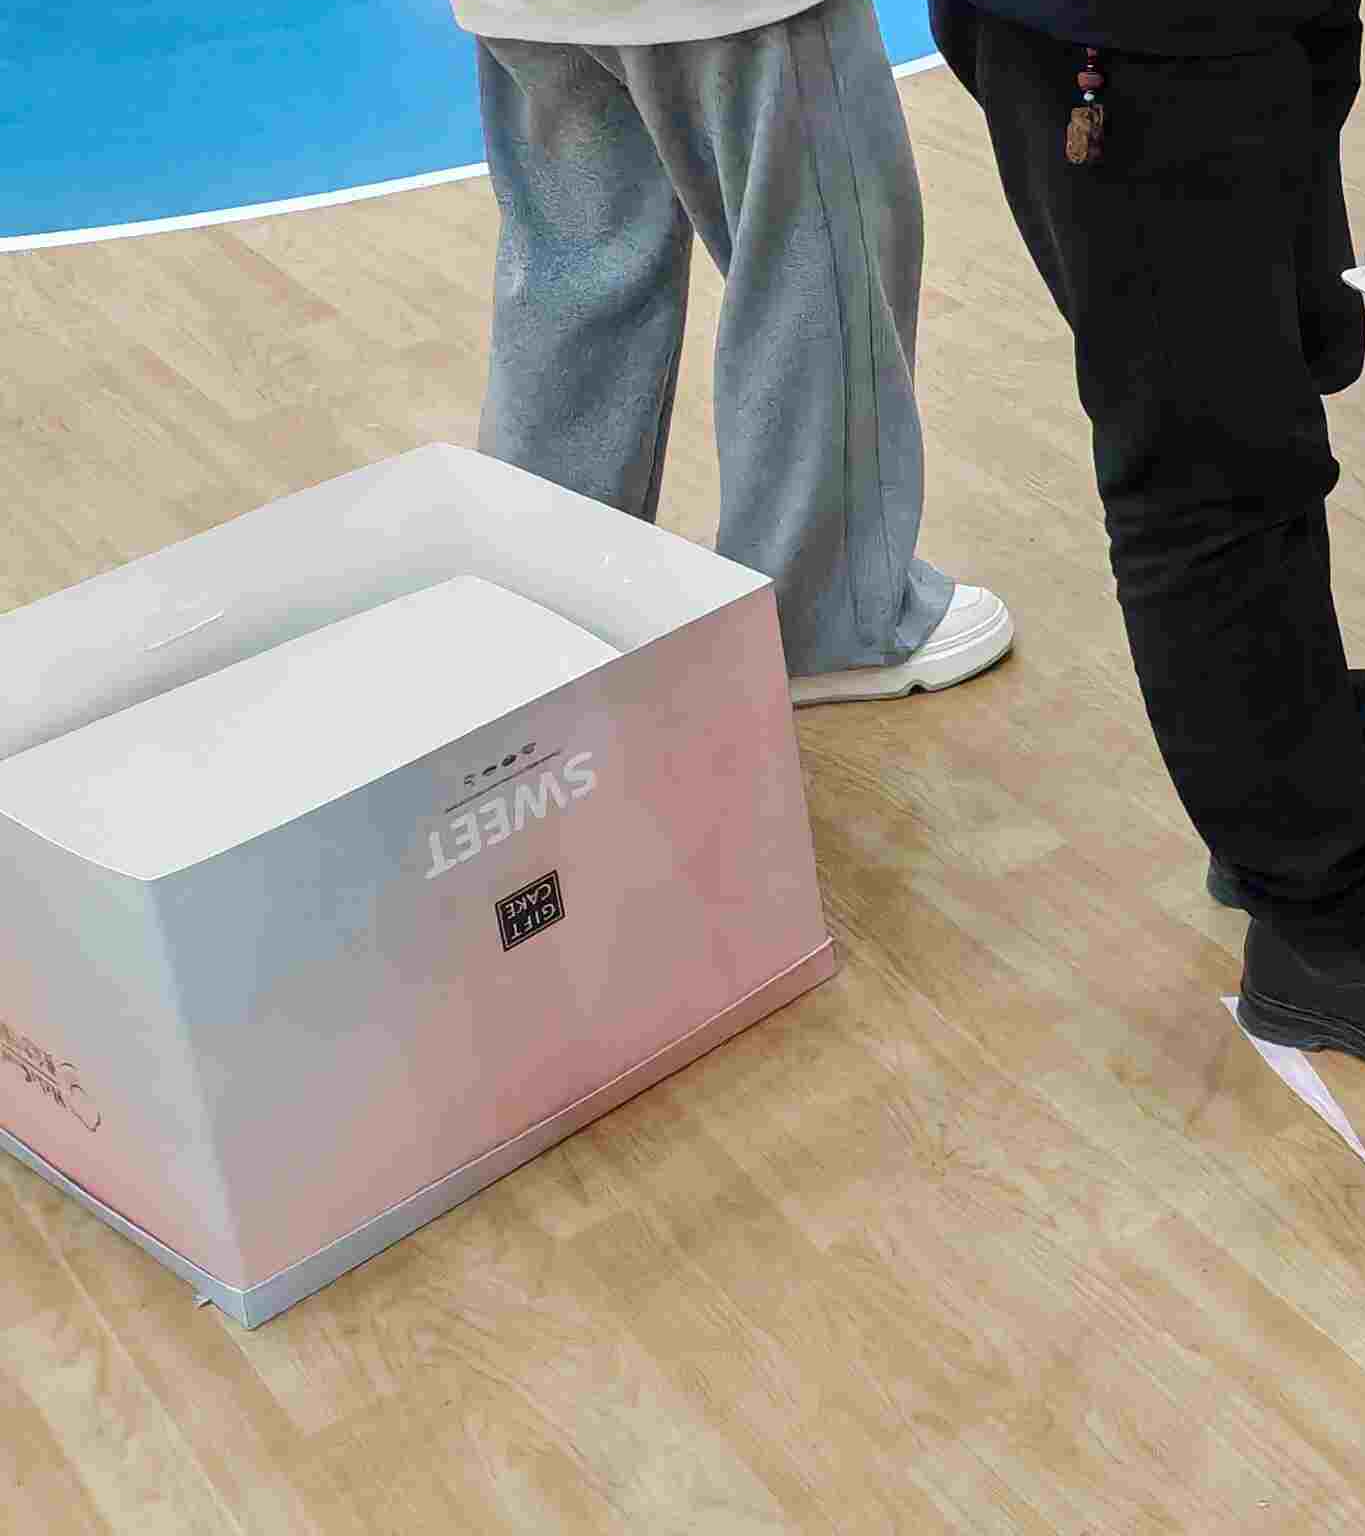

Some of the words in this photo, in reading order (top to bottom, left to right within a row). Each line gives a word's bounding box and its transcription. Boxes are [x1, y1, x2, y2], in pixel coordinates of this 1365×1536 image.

[424, 751, 598, 880] SWEET
[503, 882, 553, 919] CAKE
[511, 902, 556, 940] GIFT
